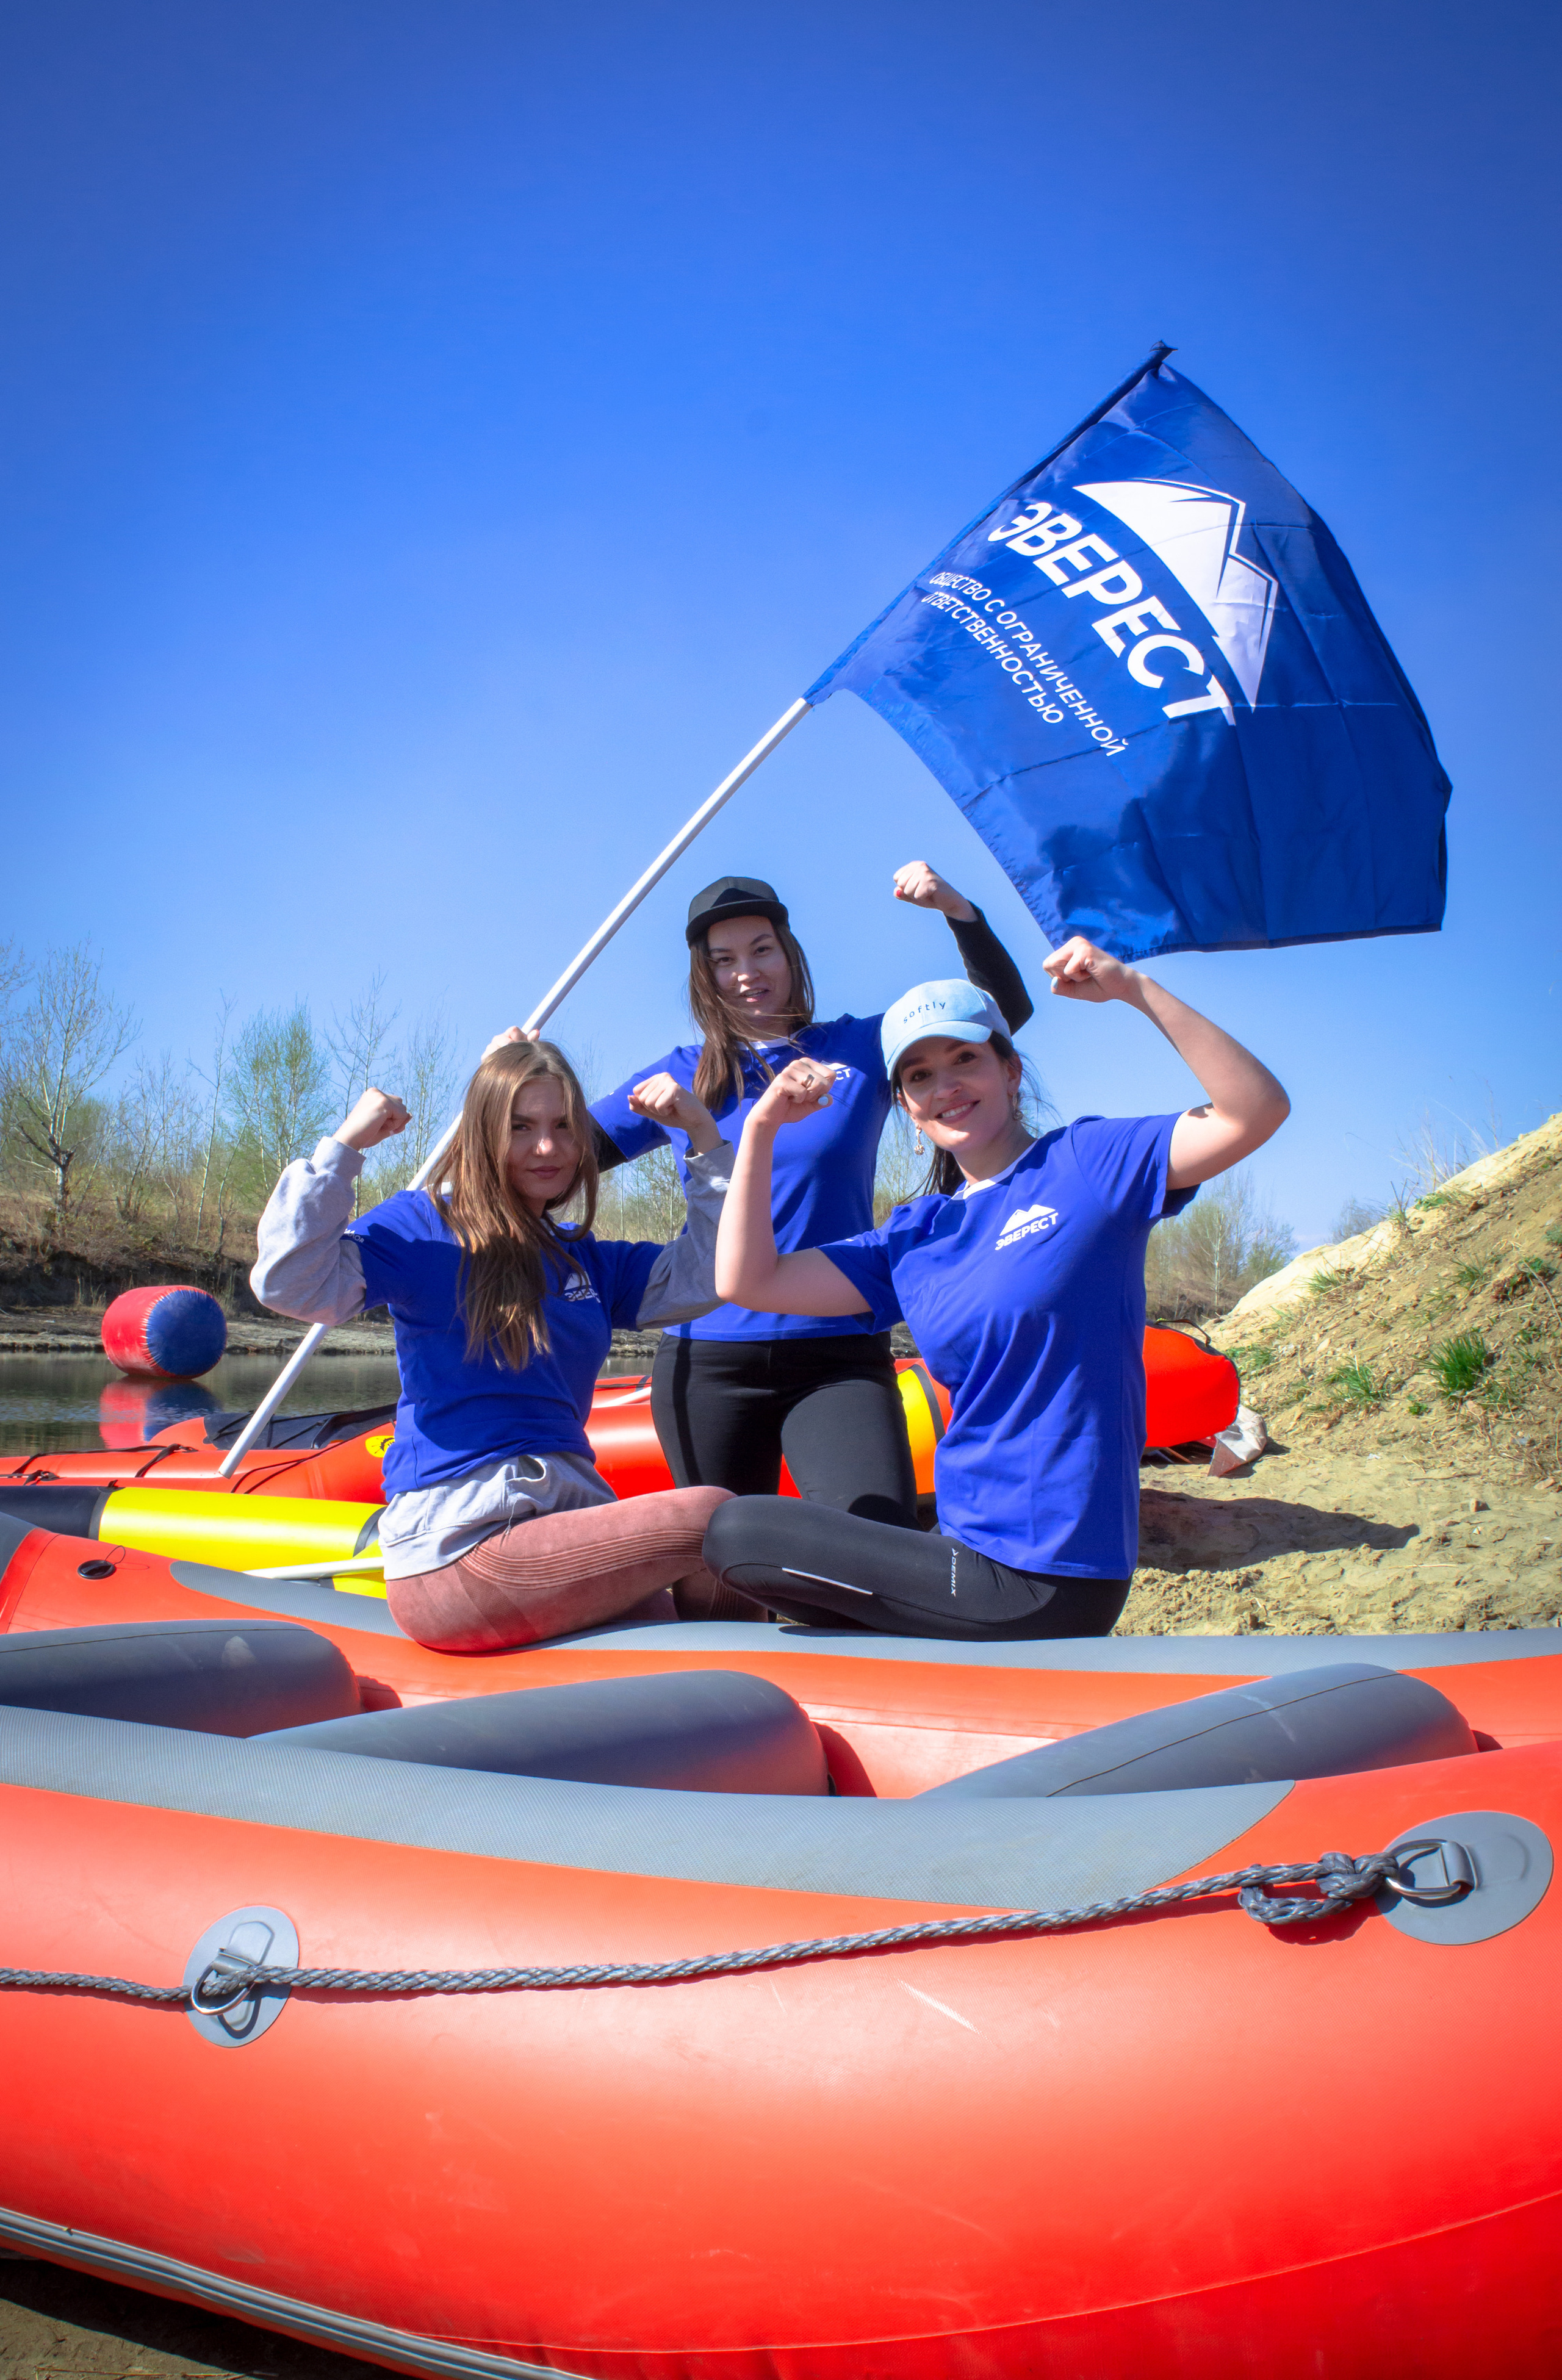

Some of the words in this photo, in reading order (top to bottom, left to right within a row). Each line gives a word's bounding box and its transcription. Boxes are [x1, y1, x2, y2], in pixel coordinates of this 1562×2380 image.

[921, 591, 1064, 724] ОТВЕТСТВЕННОСТЬЮ
[929, 572, 992, 601] ОБЩЕСТВО
[984, 599, 1005, 613] С
[996, 611, 1129, 757] ОГРАНИЧЕННОЙ
[987, 502, 1236, 726] ЭВЕРЕСТ
[903, 1001, 946, 1024] softly
[995, 1212, 1059, 1251] ЭВЕРЕСТ
